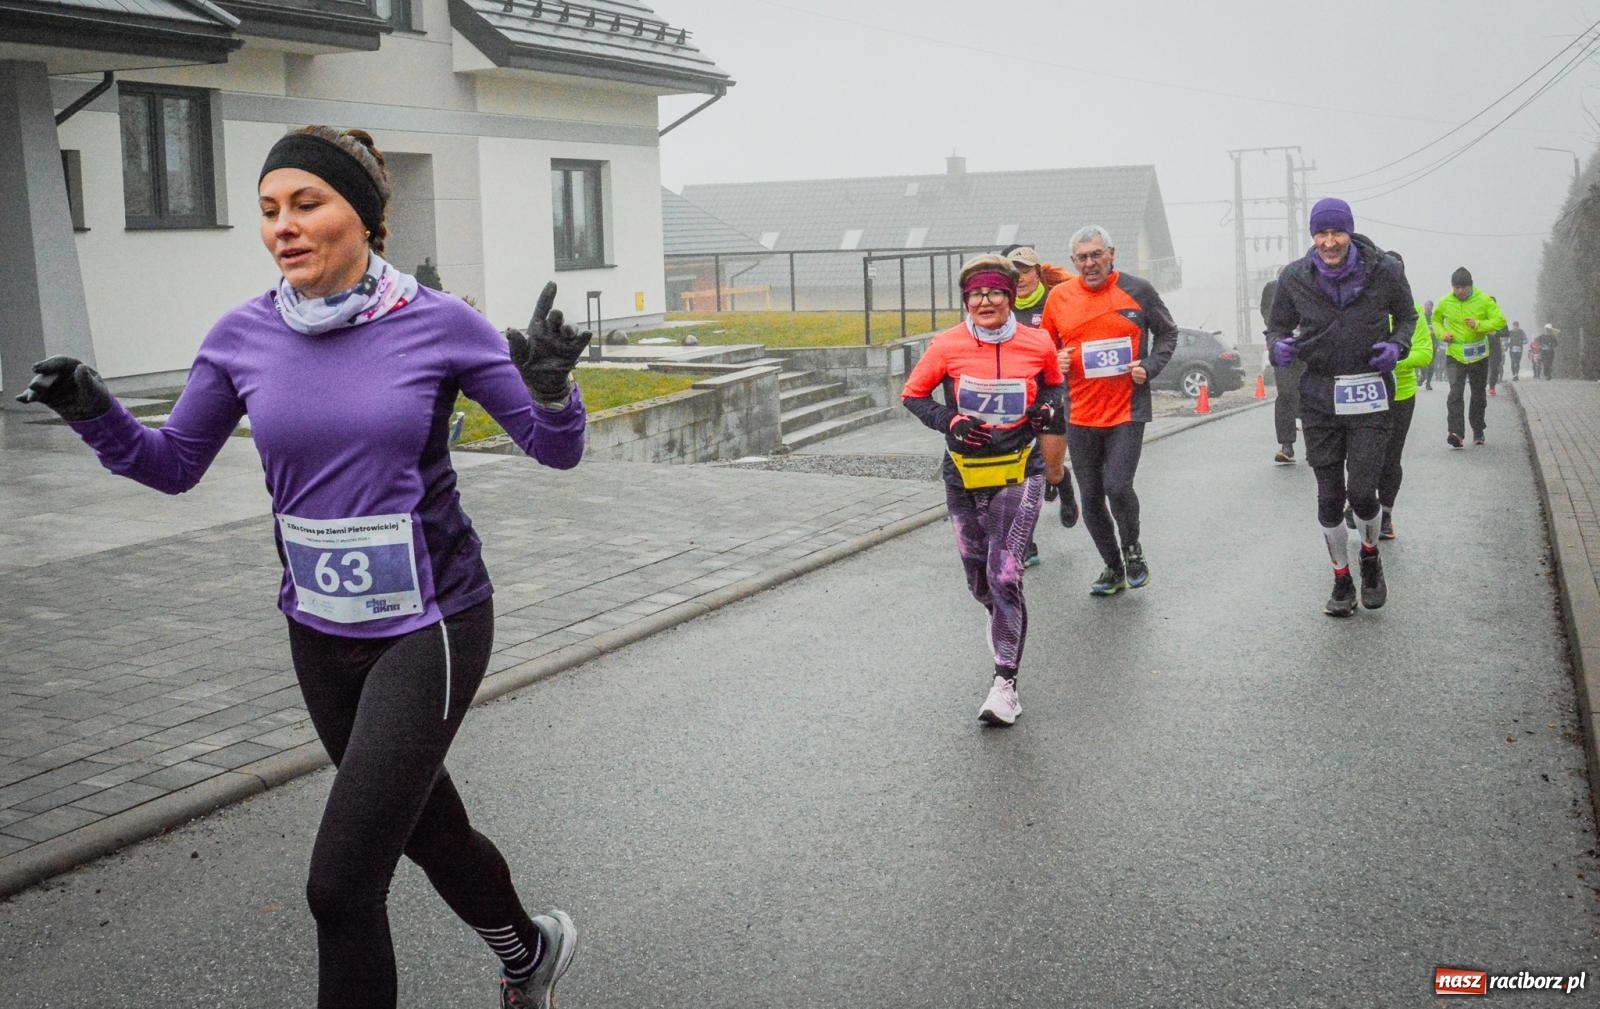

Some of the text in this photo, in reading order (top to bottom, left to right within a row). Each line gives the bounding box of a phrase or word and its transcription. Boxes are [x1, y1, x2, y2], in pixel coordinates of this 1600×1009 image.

[1096, 350, 1119, 367] 38
[976, 393, 1006, 413] 71
[1343, 383, 1379, 403] 158
[325, 527, 347, 535] Ziemi
[347, 521, 399, 533] Pietrowickiej
[314, 551, 373, 593] 63
